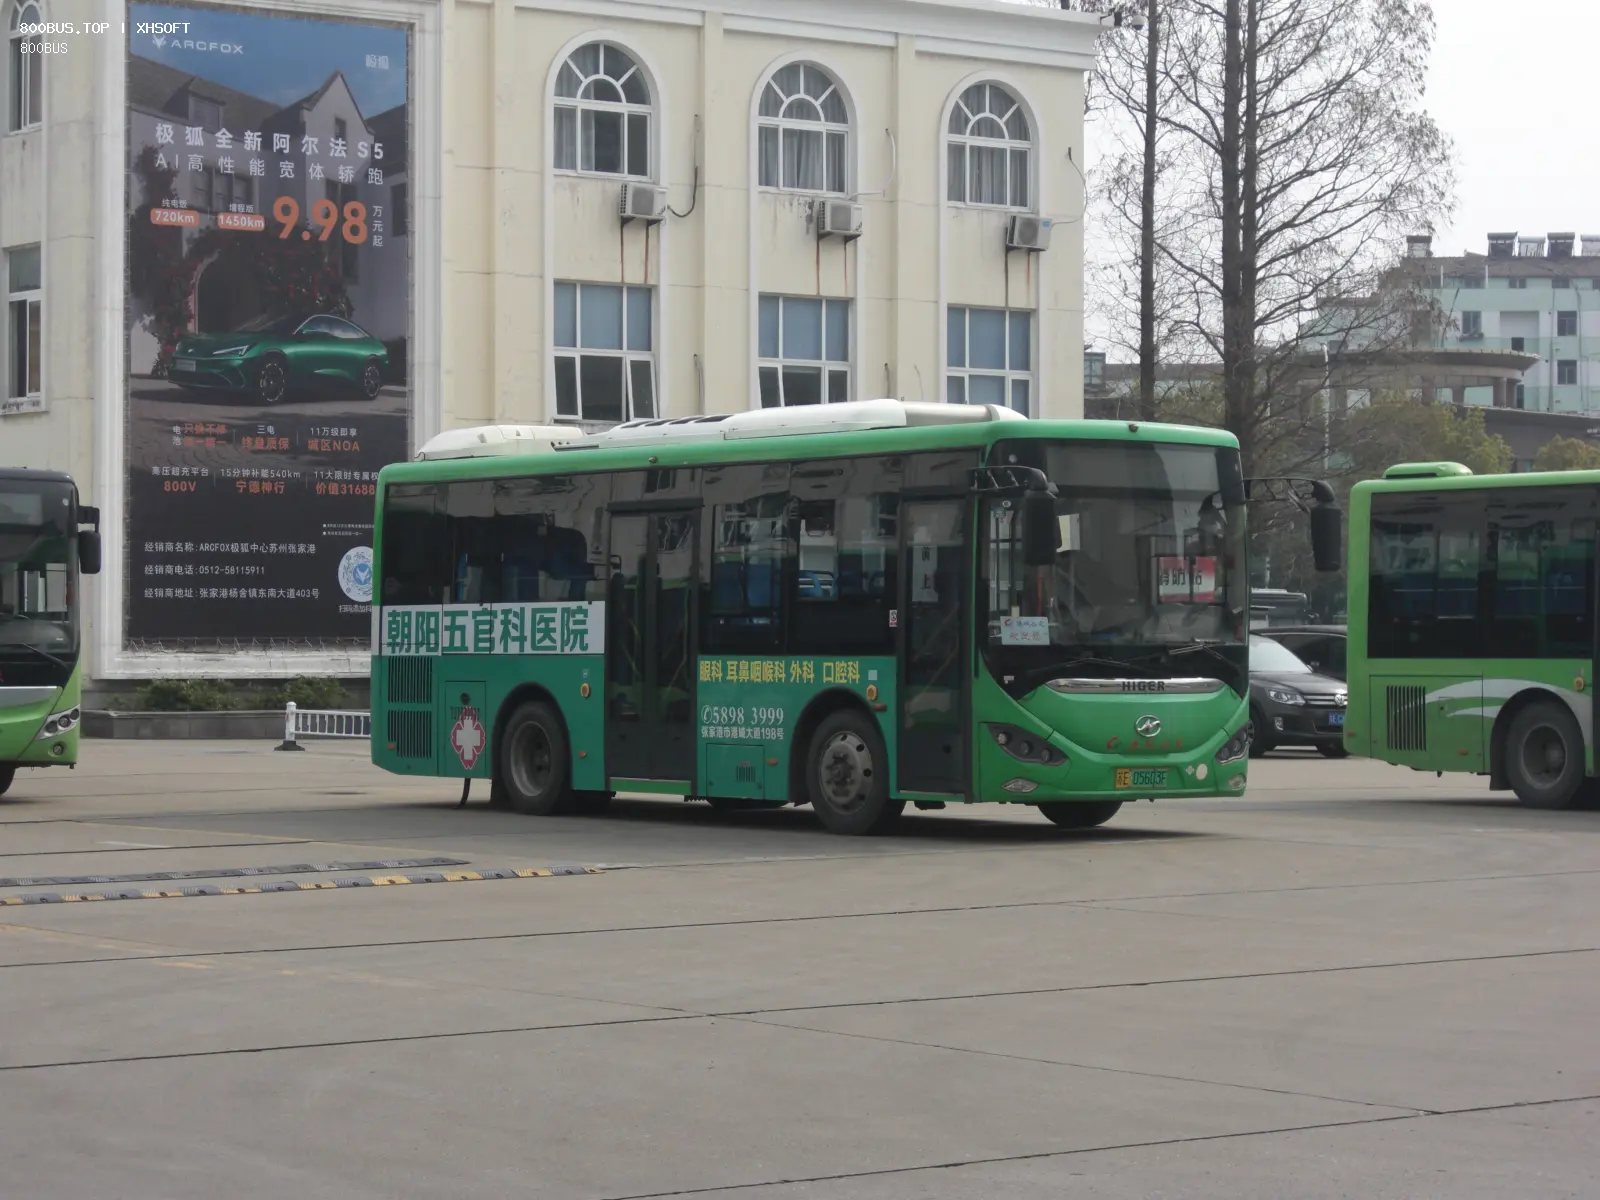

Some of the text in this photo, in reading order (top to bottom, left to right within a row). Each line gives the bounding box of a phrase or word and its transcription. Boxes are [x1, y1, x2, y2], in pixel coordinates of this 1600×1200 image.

[171, 40, 244, 55] ARCFOX
[155, 123, 384, 160] 极狐全新阿尔法S5
[156, 153, 384, 185] AI高性能宽体轿跑
[161, 198, 188, 209] 纯电版
[229, 203, 254, 213] 增程版
[155, 210, 195, 224] 720km
[219, 215, 265, 229] 1450km
[273, 196, 367, 244] 9.98
[372, 205, 384, 247] 万元起
[257, 425, 275, 435] 三电
[310, 427, 358, 438] 11万级即享
[307, 440, 360, 452] 城区NOA
[152, 466, 209, 477] 高压超充平台
[220, 468, 300, 479] 15分钟补能540km
[164, 481, 197, 492] 800V
[236, 481, 285, 494] 宁德神行
[387, 606, 589, 654] 朝阳五官科医院
[700, 660, 860, 684] 眼科 耳鼻咽喉科 外科 口腔科
[1122, 681, 1165, 691] HIGER
[712, 706, 784, 725] 5898 3999
[701, 726, 784, 740] 张家港市港城大道198号
